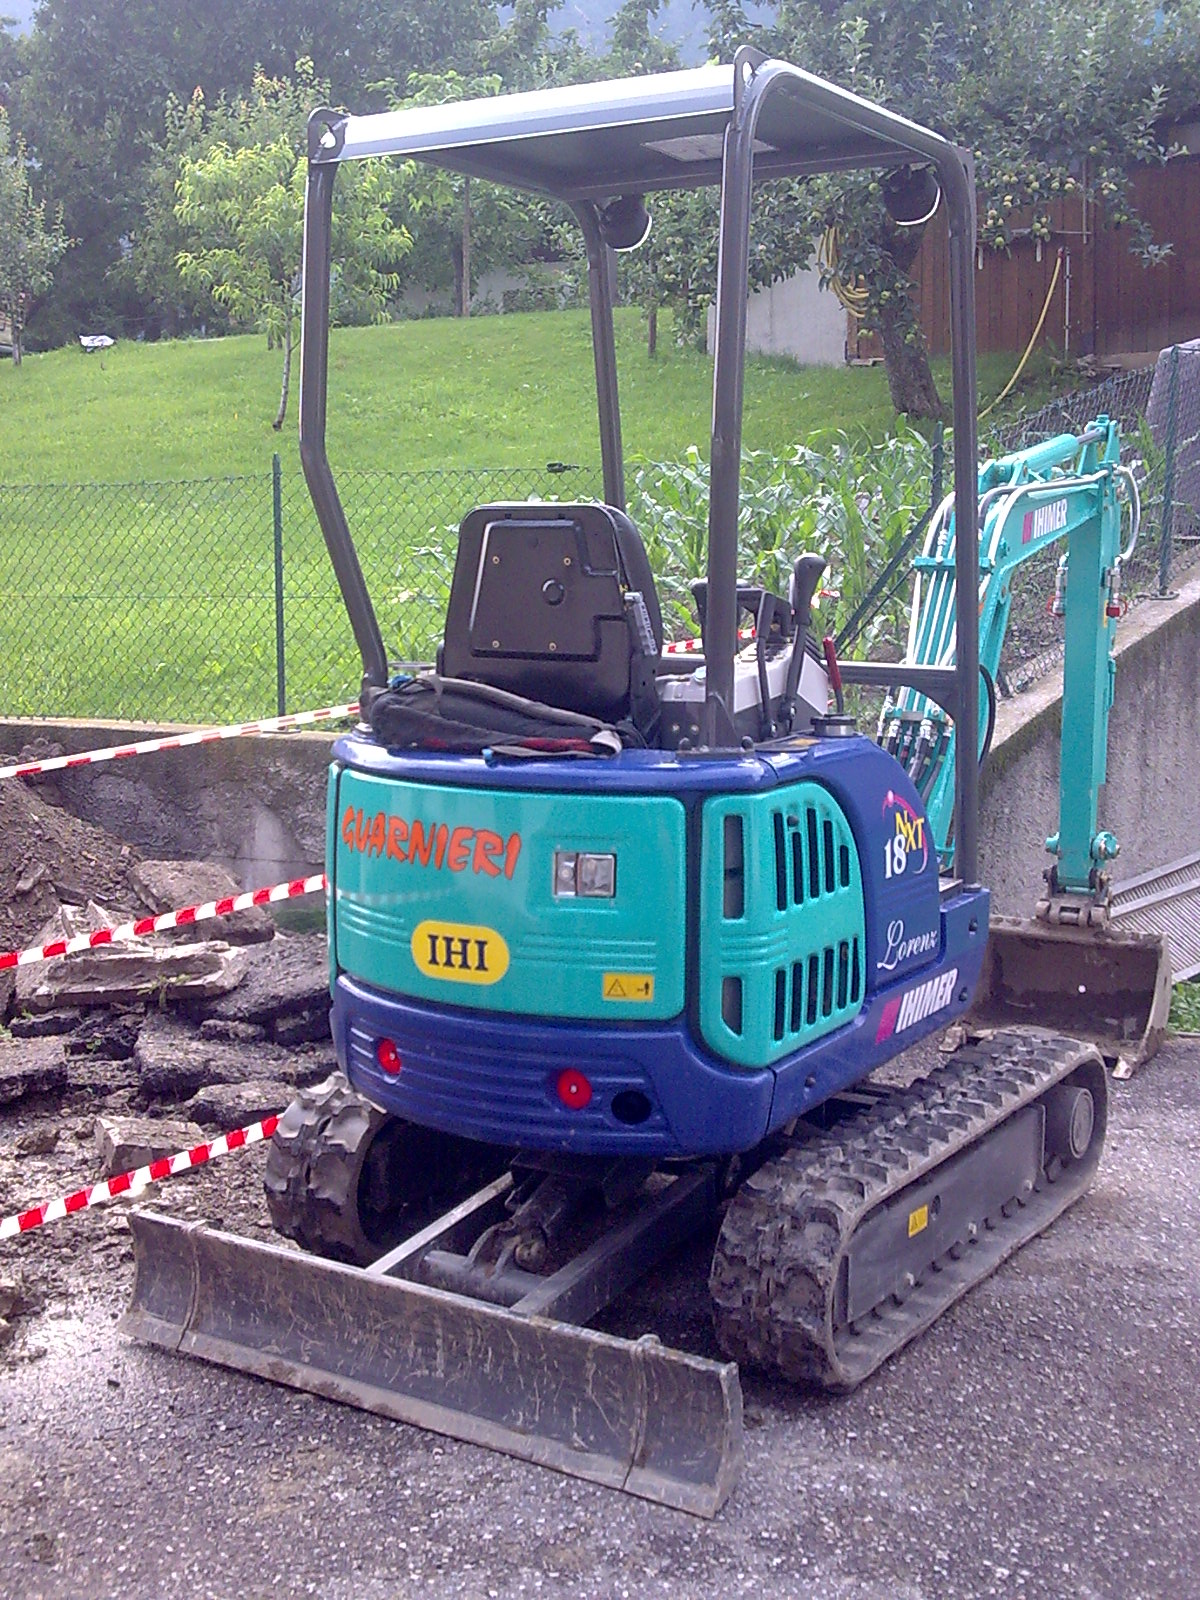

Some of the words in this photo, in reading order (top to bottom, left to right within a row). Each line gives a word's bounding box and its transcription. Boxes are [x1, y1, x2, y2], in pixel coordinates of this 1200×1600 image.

[1033, 498, 1068, 539] IHIMER
[341, 805, 522, 880] GUARNIERI
[884, 834, 906, 879] 18
[896, 810, 924, 853] NXT
[427, 934, 489, 971] IHI
[895, 967, 958, 1034] IHIMER
